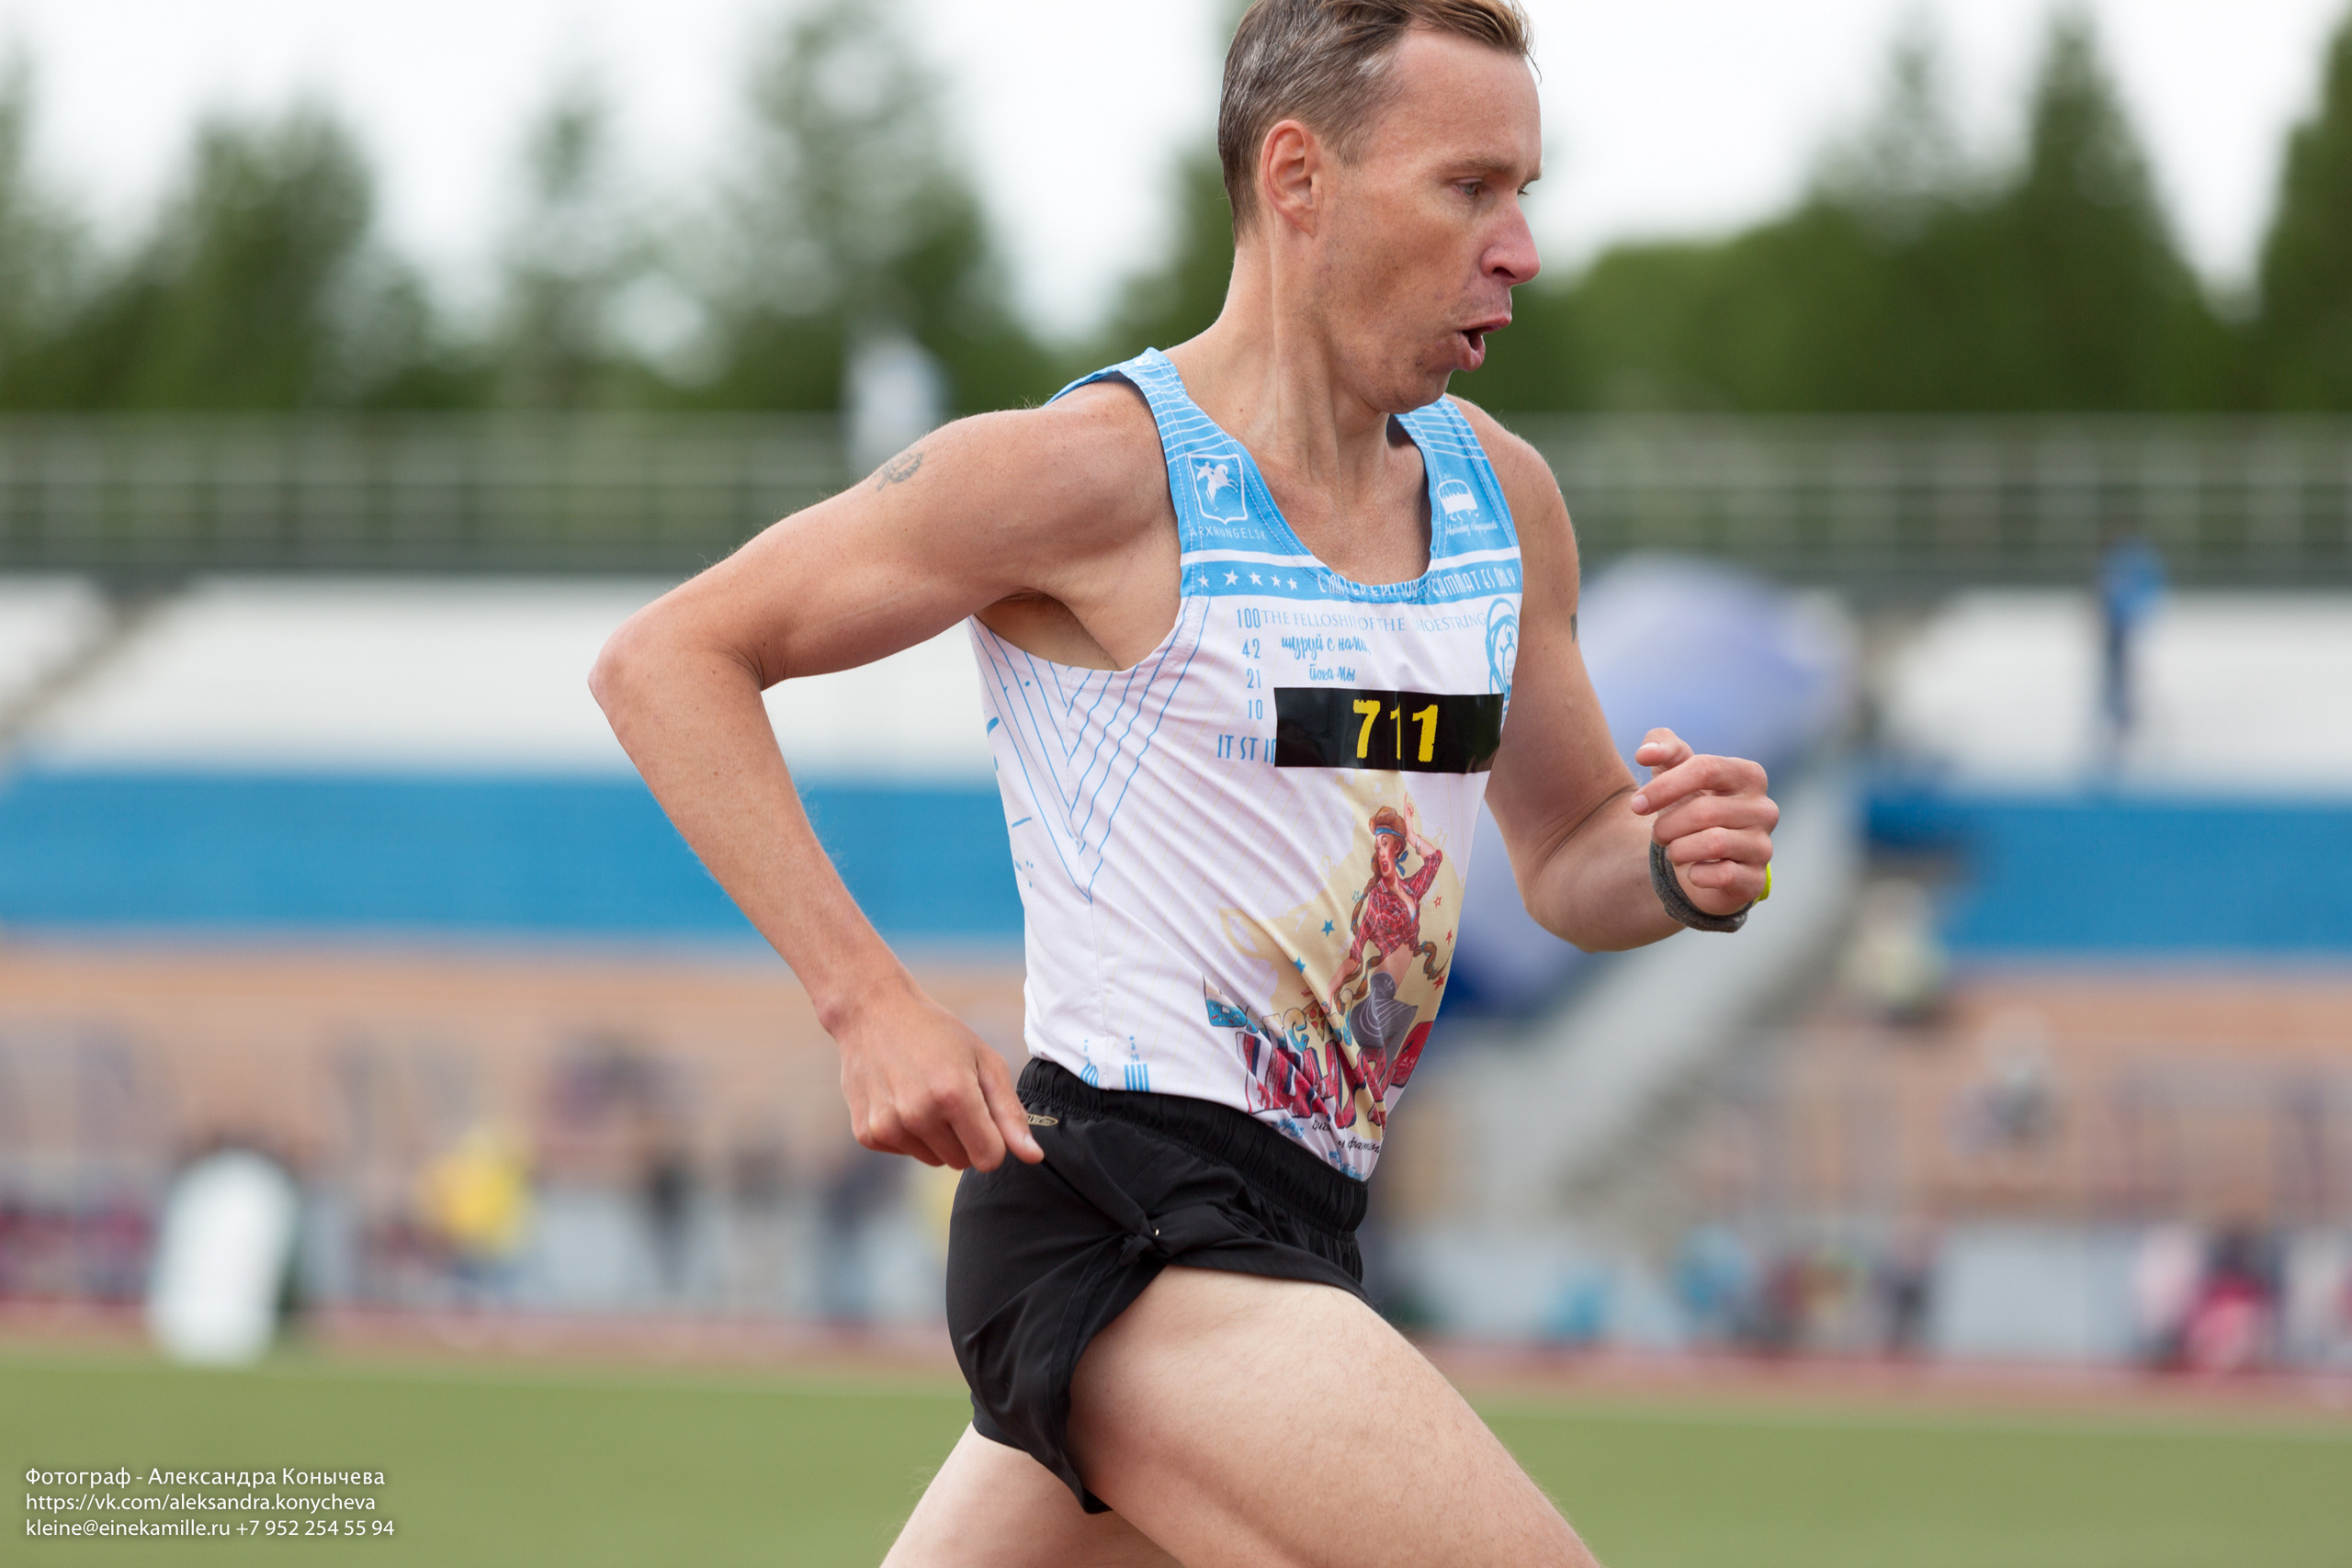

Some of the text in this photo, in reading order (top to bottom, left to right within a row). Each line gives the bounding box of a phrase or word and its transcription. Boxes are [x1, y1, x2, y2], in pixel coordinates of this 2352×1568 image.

[1237, 607, 1261, 629] 100
[1261, 610, 1290, 626] THE
[1377, 617, 1406, 632] THE
[1242, 637, 1261, 660] 42
[1246, 668, 1261, 689] 21
[1248, 699, 1263, 720] 10
[1352, 698, 1439, 763] 711
